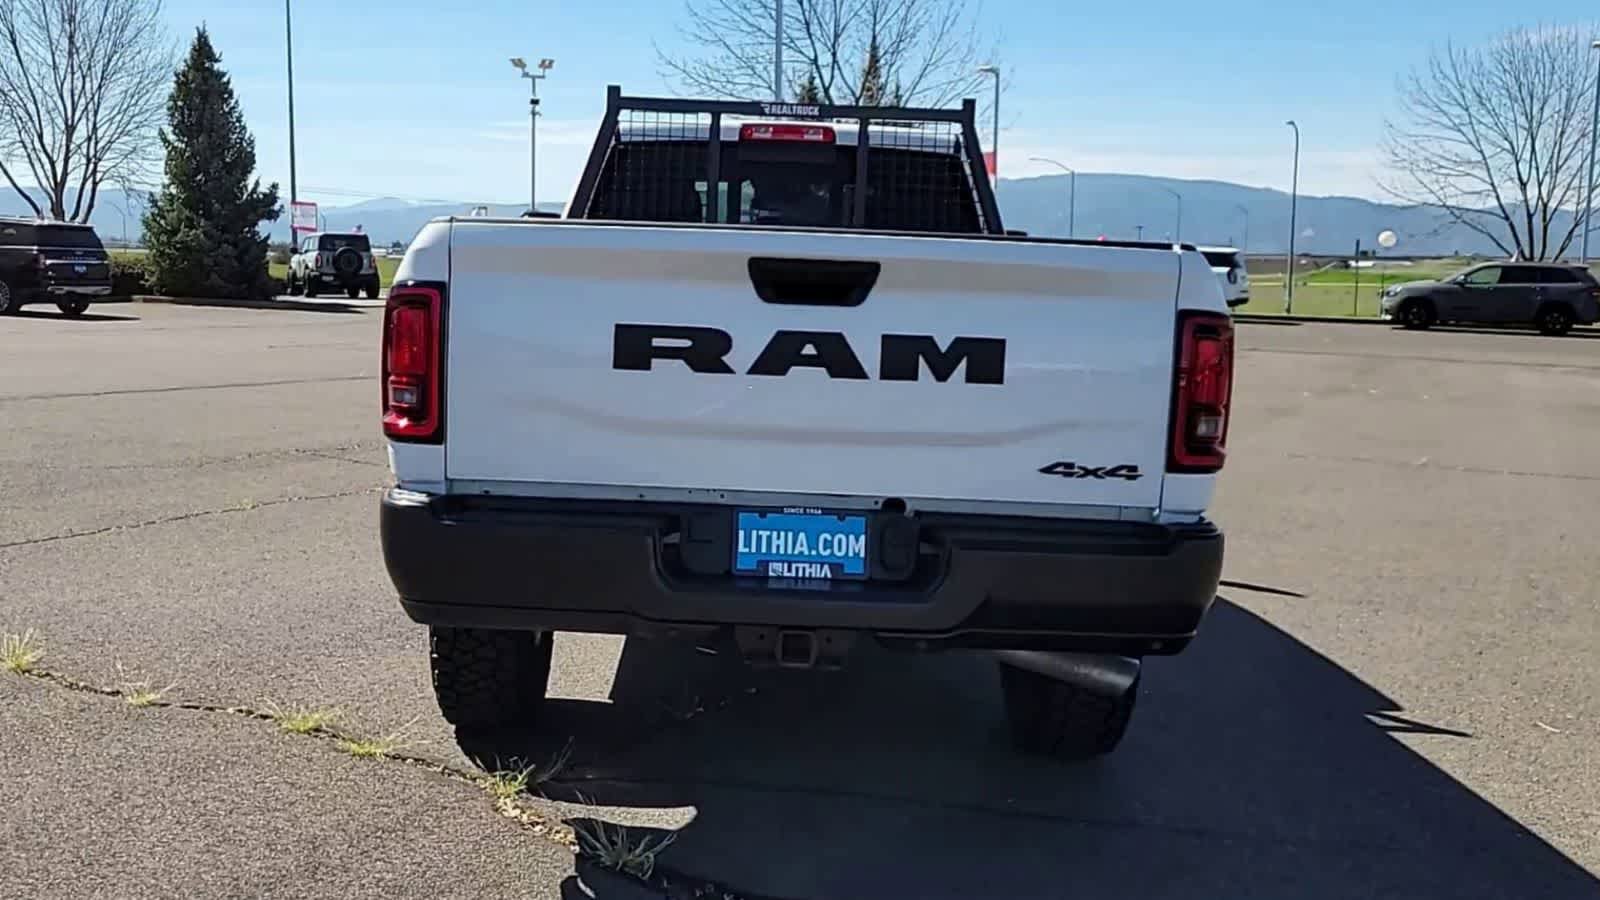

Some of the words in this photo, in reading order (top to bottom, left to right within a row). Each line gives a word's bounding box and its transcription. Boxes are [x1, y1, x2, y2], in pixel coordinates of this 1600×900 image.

[612, 323, 1007, 385] RAM
[738, 529, 866, 558] LITHIA.COM
[783, 563, 832, 578] LITHIA
